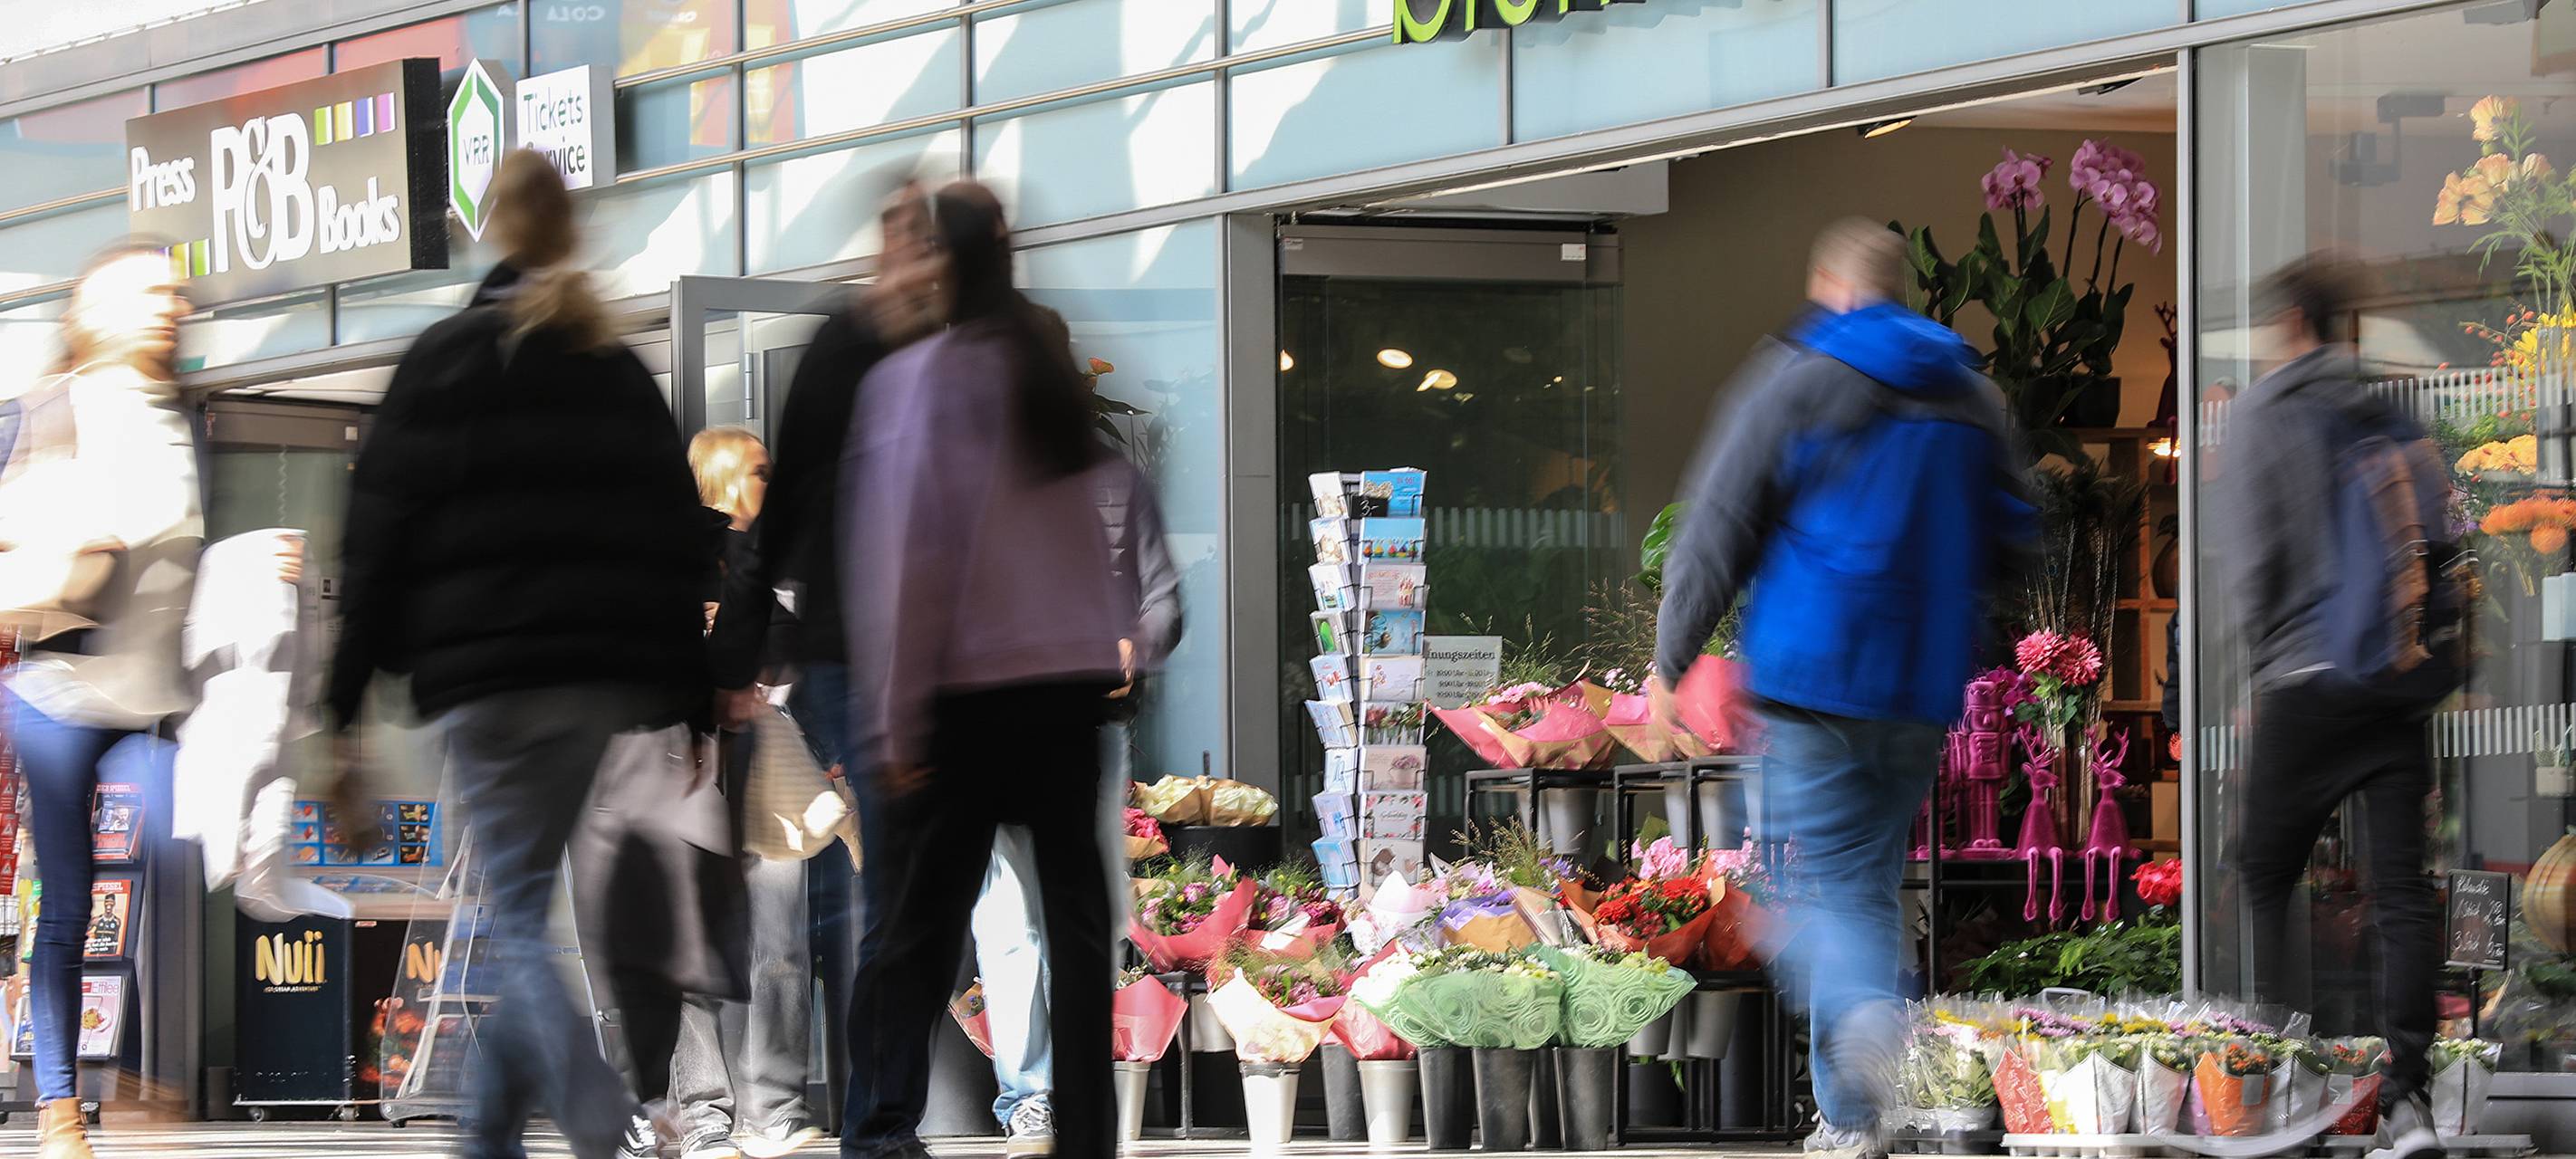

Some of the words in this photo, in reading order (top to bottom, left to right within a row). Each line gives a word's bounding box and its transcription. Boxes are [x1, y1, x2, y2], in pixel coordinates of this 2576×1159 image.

[523, 87, 583, 133] Tickets
[463, 135, 490, 166] VRR
[526, 136, 585, 176] rvice
[130, 146, 196, 212] Press
[211, 112, 314, 273] P&B
[317, 176, 400, 254] Books
